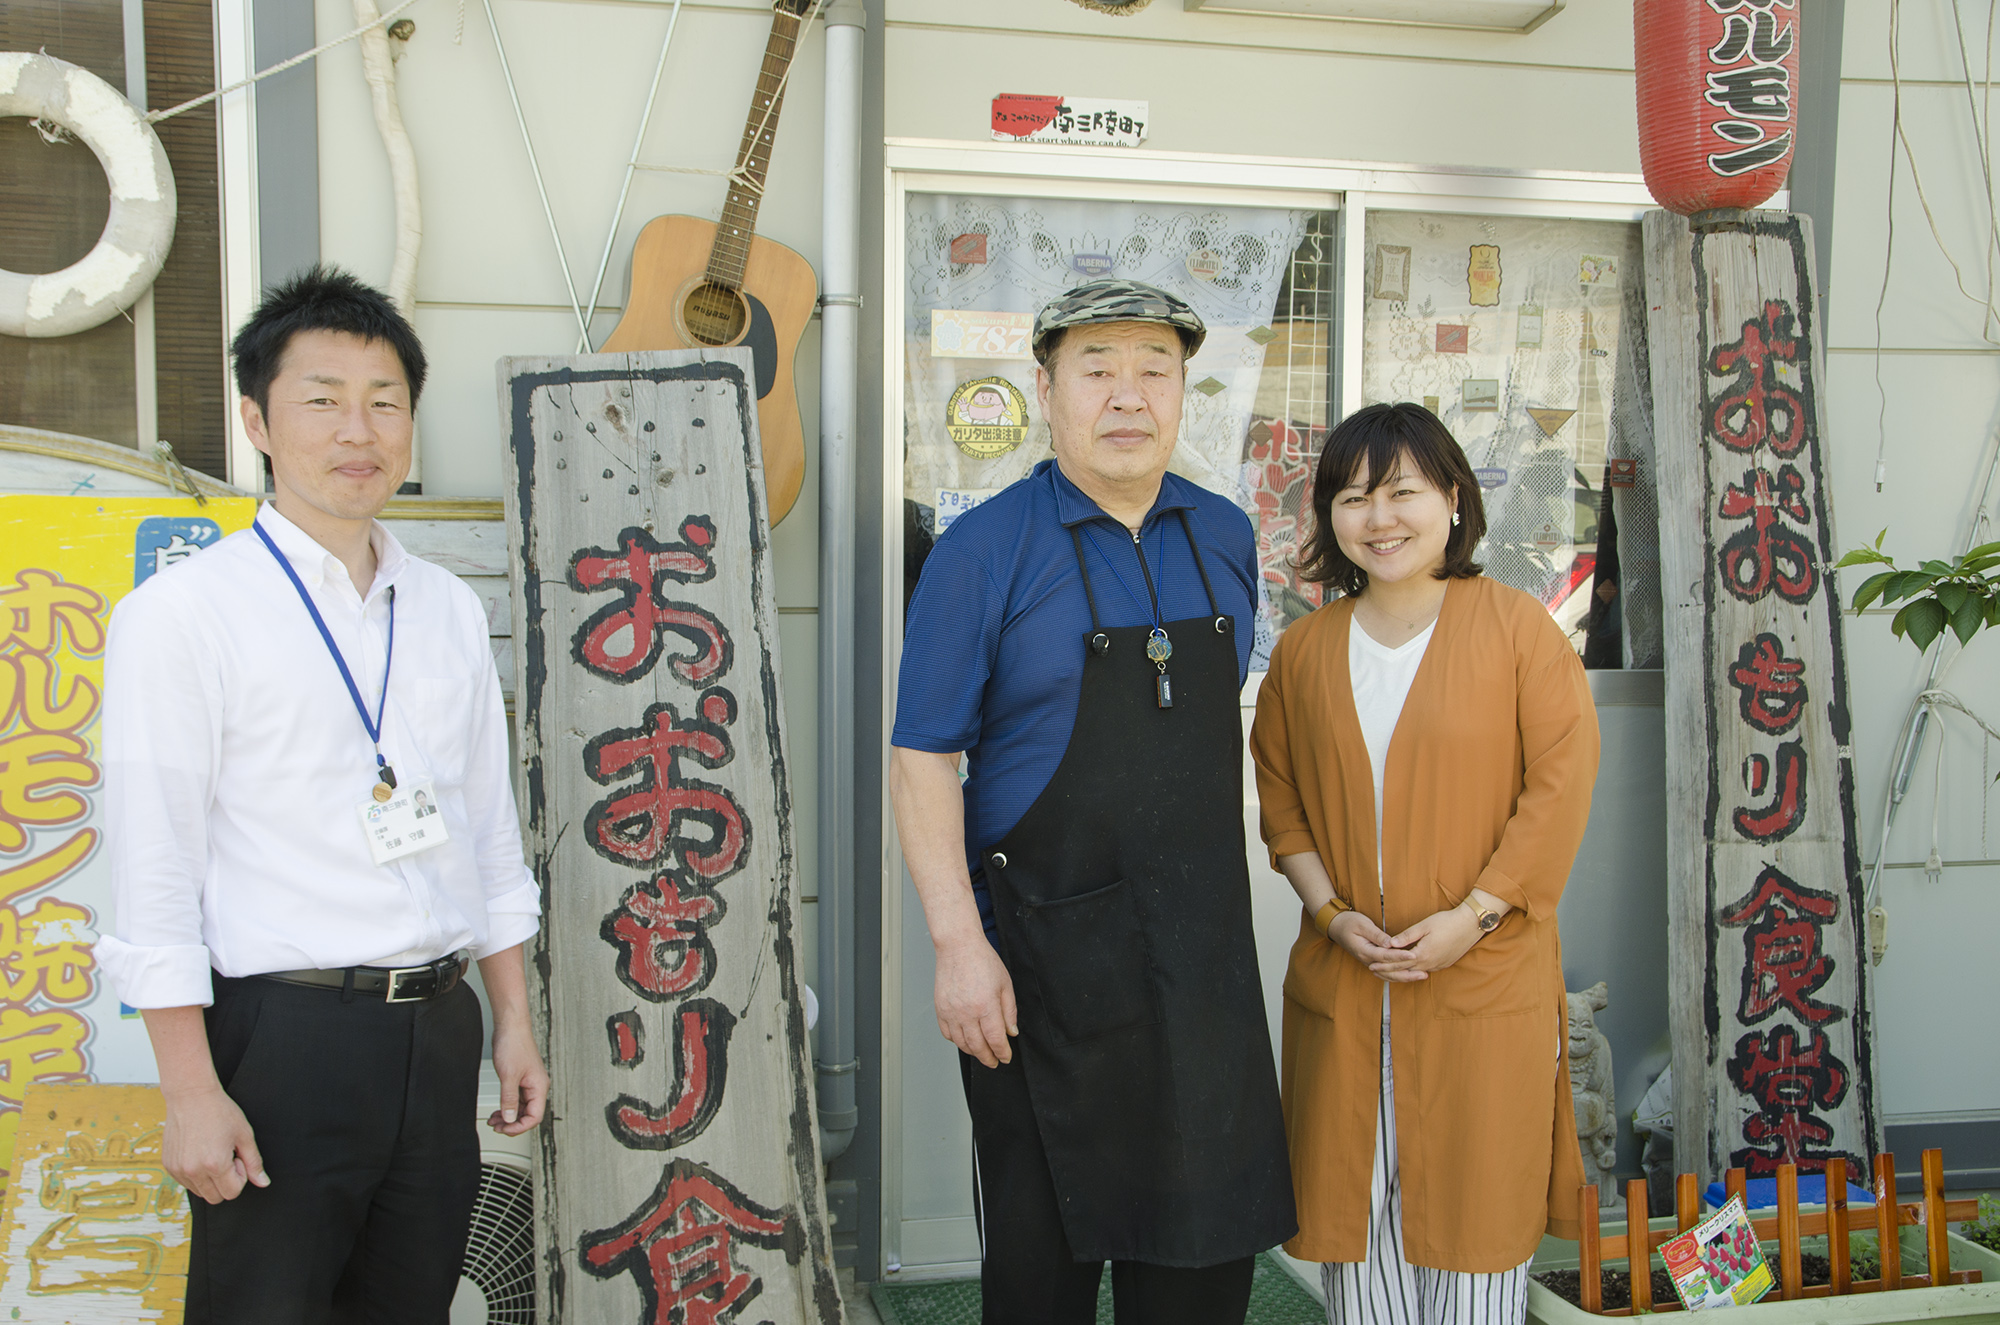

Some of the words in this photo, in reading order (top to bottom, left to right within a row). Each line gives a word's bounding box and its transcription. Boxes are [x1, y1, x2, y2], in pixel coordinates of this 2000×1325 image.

[1702, 0, 1794, 177] ルモン
[1052, 103, 1145, 138] 南三陸町
[1037, 136, 1058, 145] start
[1060, 137, 1082, 146] what
[1098, 139, 1114, 147] can
[1077, 257, 1111, 268] TABERNA
[953, 427, 1022, 441] ガリタ出没注意
[1698, 1202, 1739, 1238] メリークリスマス
